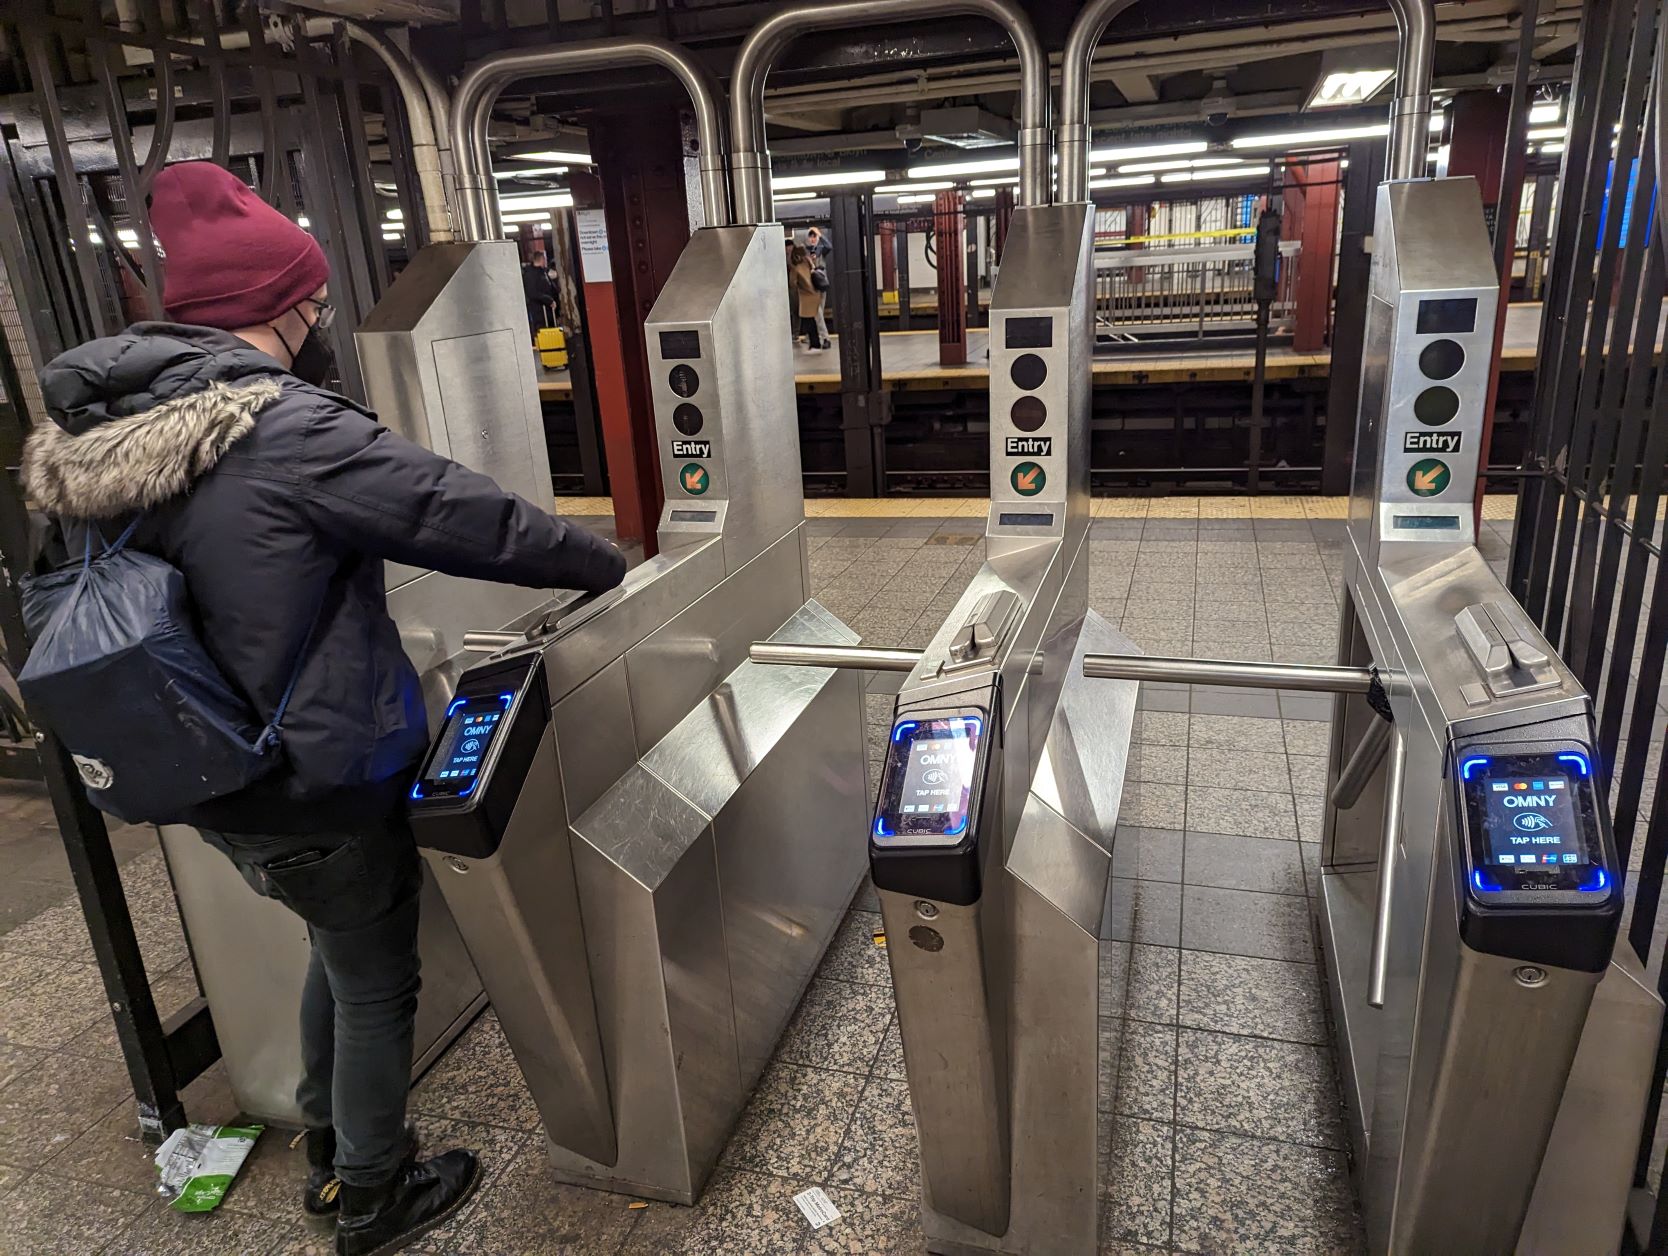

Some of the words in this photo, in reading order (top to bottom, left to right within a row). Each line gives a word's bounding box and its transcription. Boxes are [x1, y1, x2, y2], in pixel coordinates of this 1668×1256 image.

[1007, 438, 1050, 455] Entry
[1405, 432, 1459, 452] Entry
[672, 441, 710, 458] Entry
[464, 725, 493, 736] OMNY
[463, 755, 479, 763] HERE
[920, 754, 956, 765] OMNY
[930, 788, 950, 796] HERE
[1503, 795, 1557, 808] OMNY
[1510, 836, 1530, 844] TAP
[1532, 836, 1561, 844] HERE
